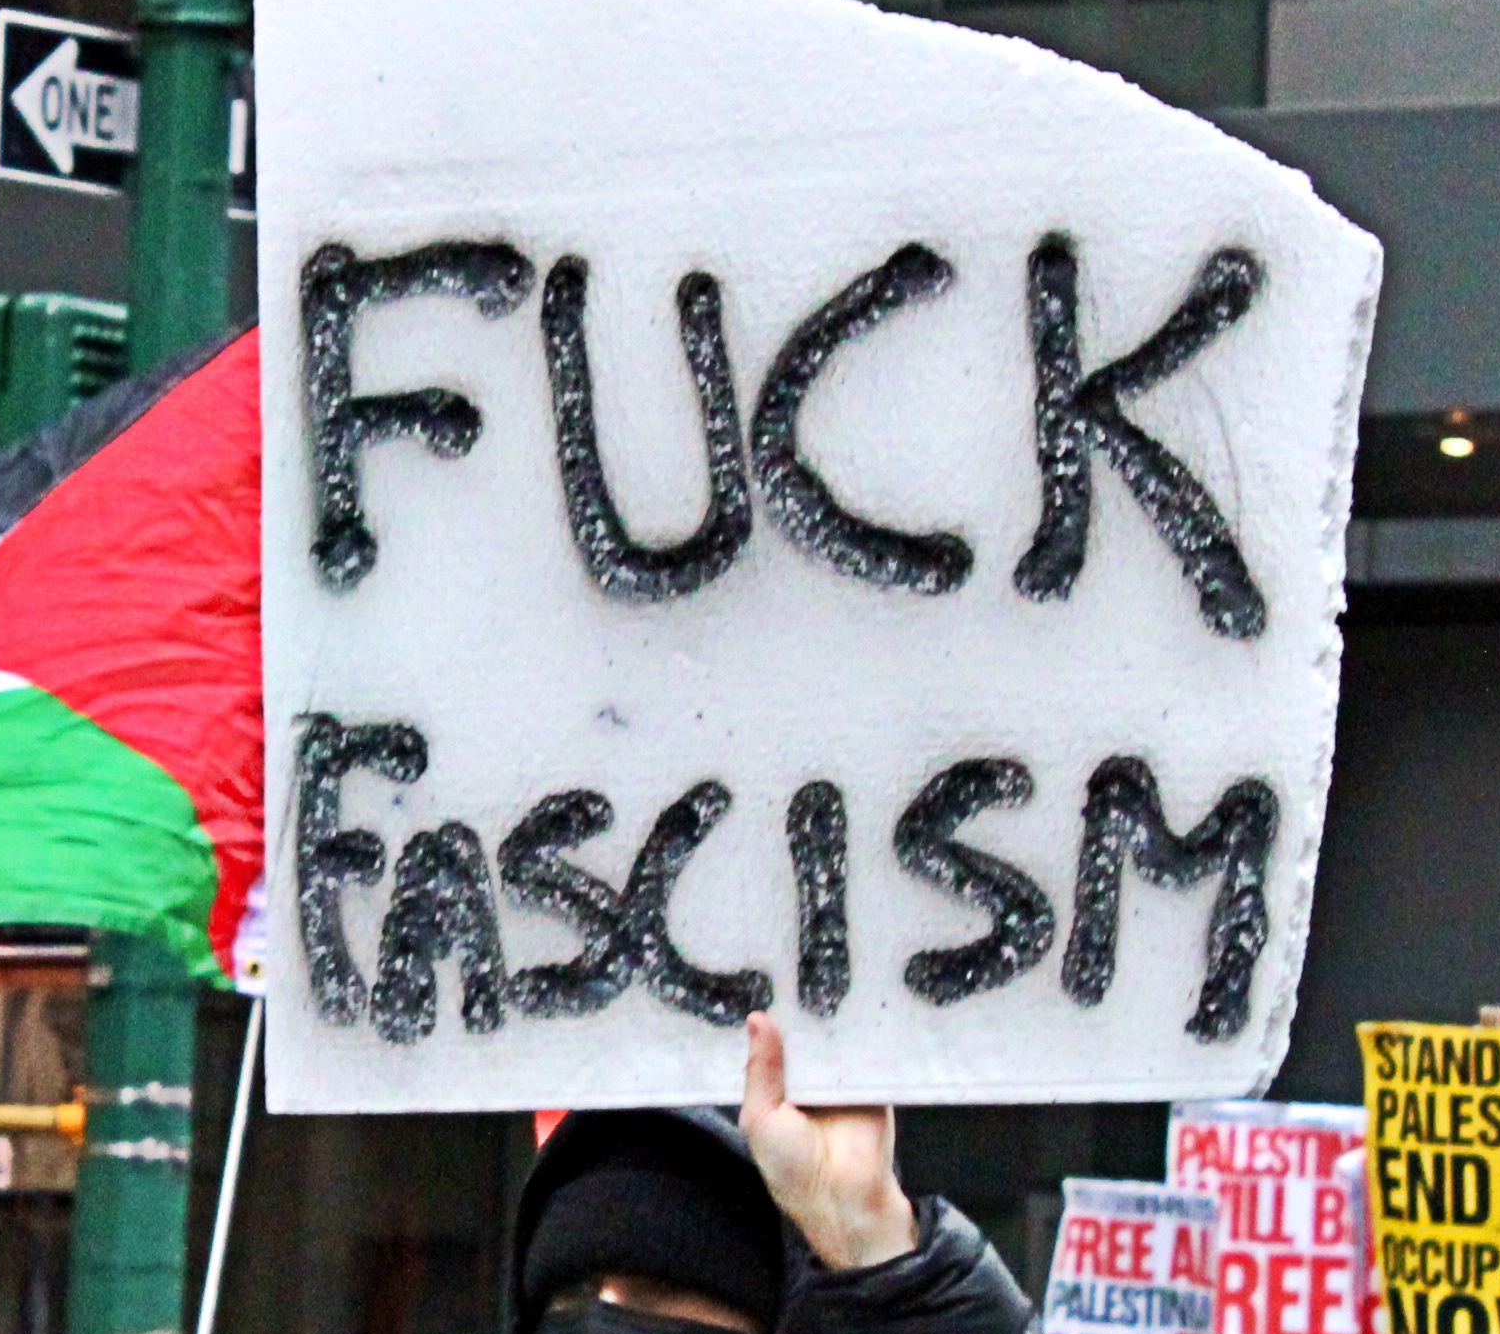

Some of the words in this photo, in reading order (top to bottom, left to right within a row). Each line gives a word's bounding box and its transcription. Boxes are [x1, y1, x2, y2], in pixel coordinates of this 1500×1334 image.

[41, 75, 117, 141] ONE
[296, 227, 1268, 641] FUCK
[1379, 1147, 1492, 1226] END
